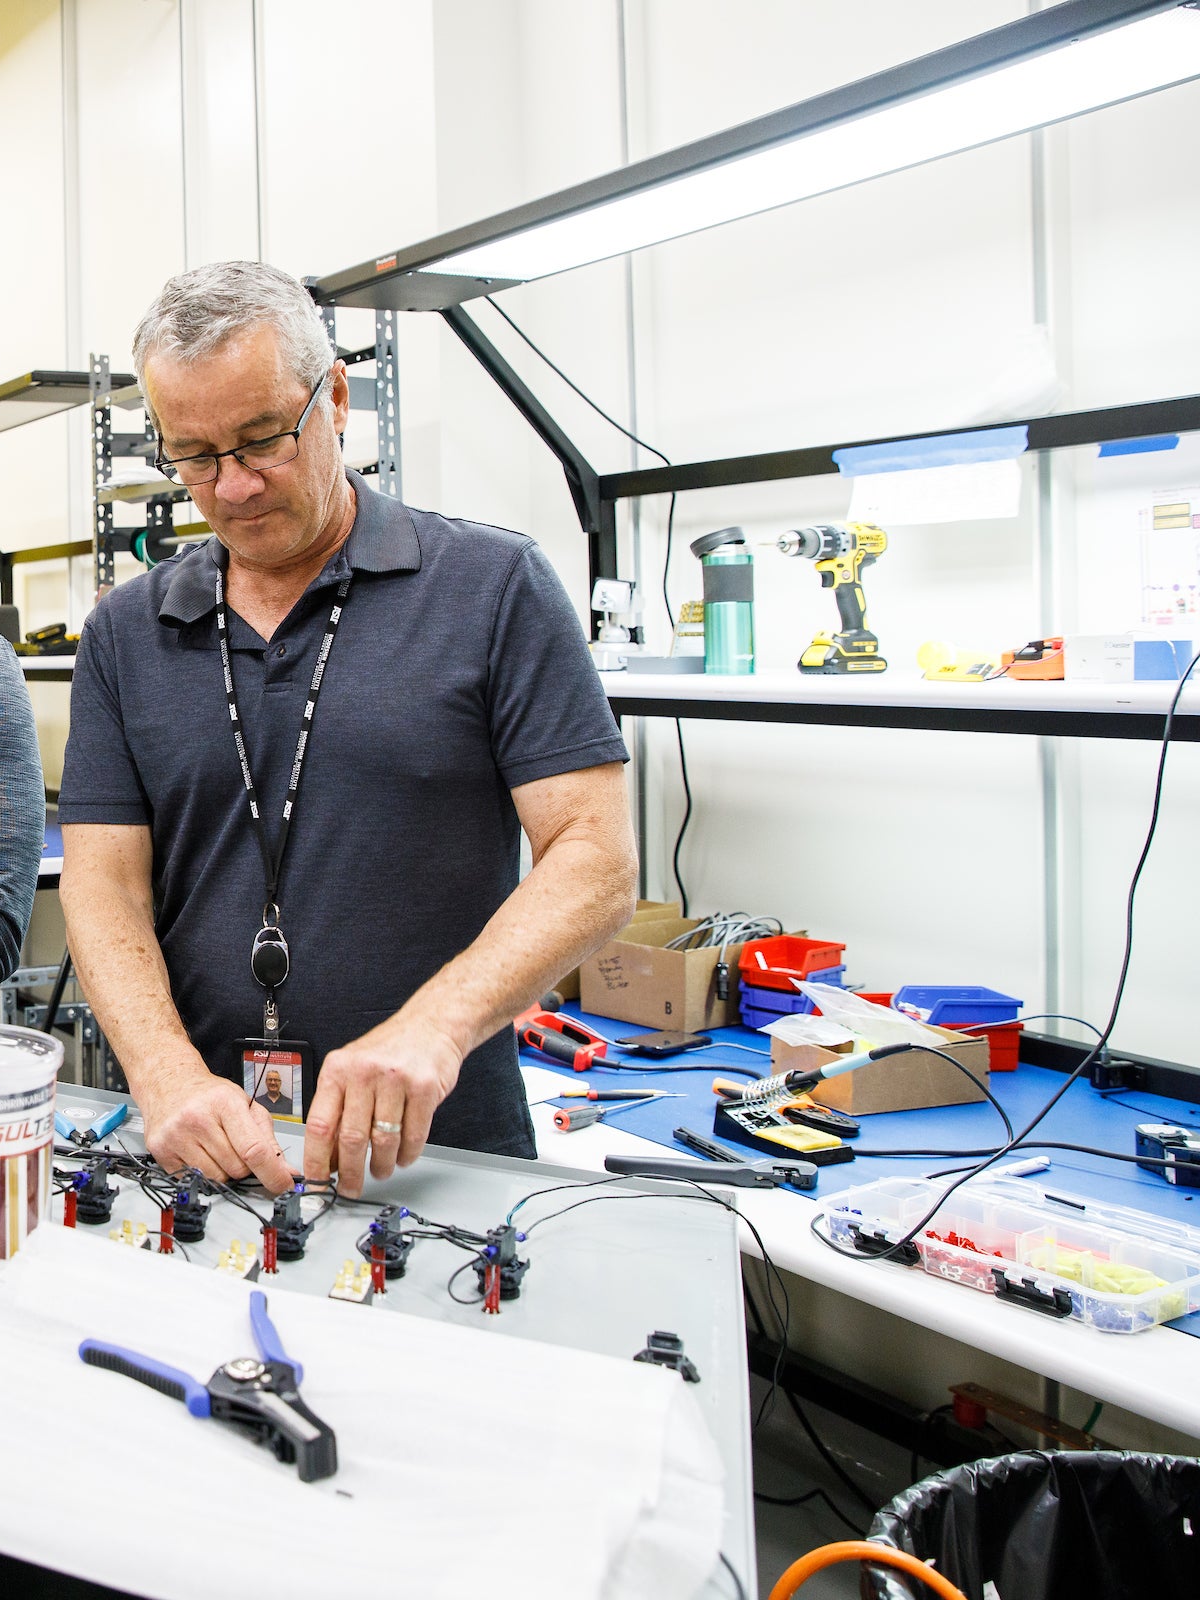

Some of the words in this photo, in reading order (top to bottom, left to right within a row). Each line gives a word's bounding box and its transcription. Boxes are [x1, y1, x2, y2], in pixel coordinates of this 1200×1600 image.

[217, 612, 226, 630] ASU
[330, 605, 342, 625] ASU
[321, 633, 334, 661] BIODESIGN
[312, 661, 325, 690] INSTITUTE
[228, 702, 238, 721] ASU
[304, 700, 315, 721] ASU
[299, 731, 308, 760] BIODESIGN
[292, 760, 302, 790] INSTITUTE
[249, 800, 260, 819] ASU
[282, 800, 293, 821] ASU
[665, 1001, 672, 1015] B
[254, 1050, 269, 1058] ASU
